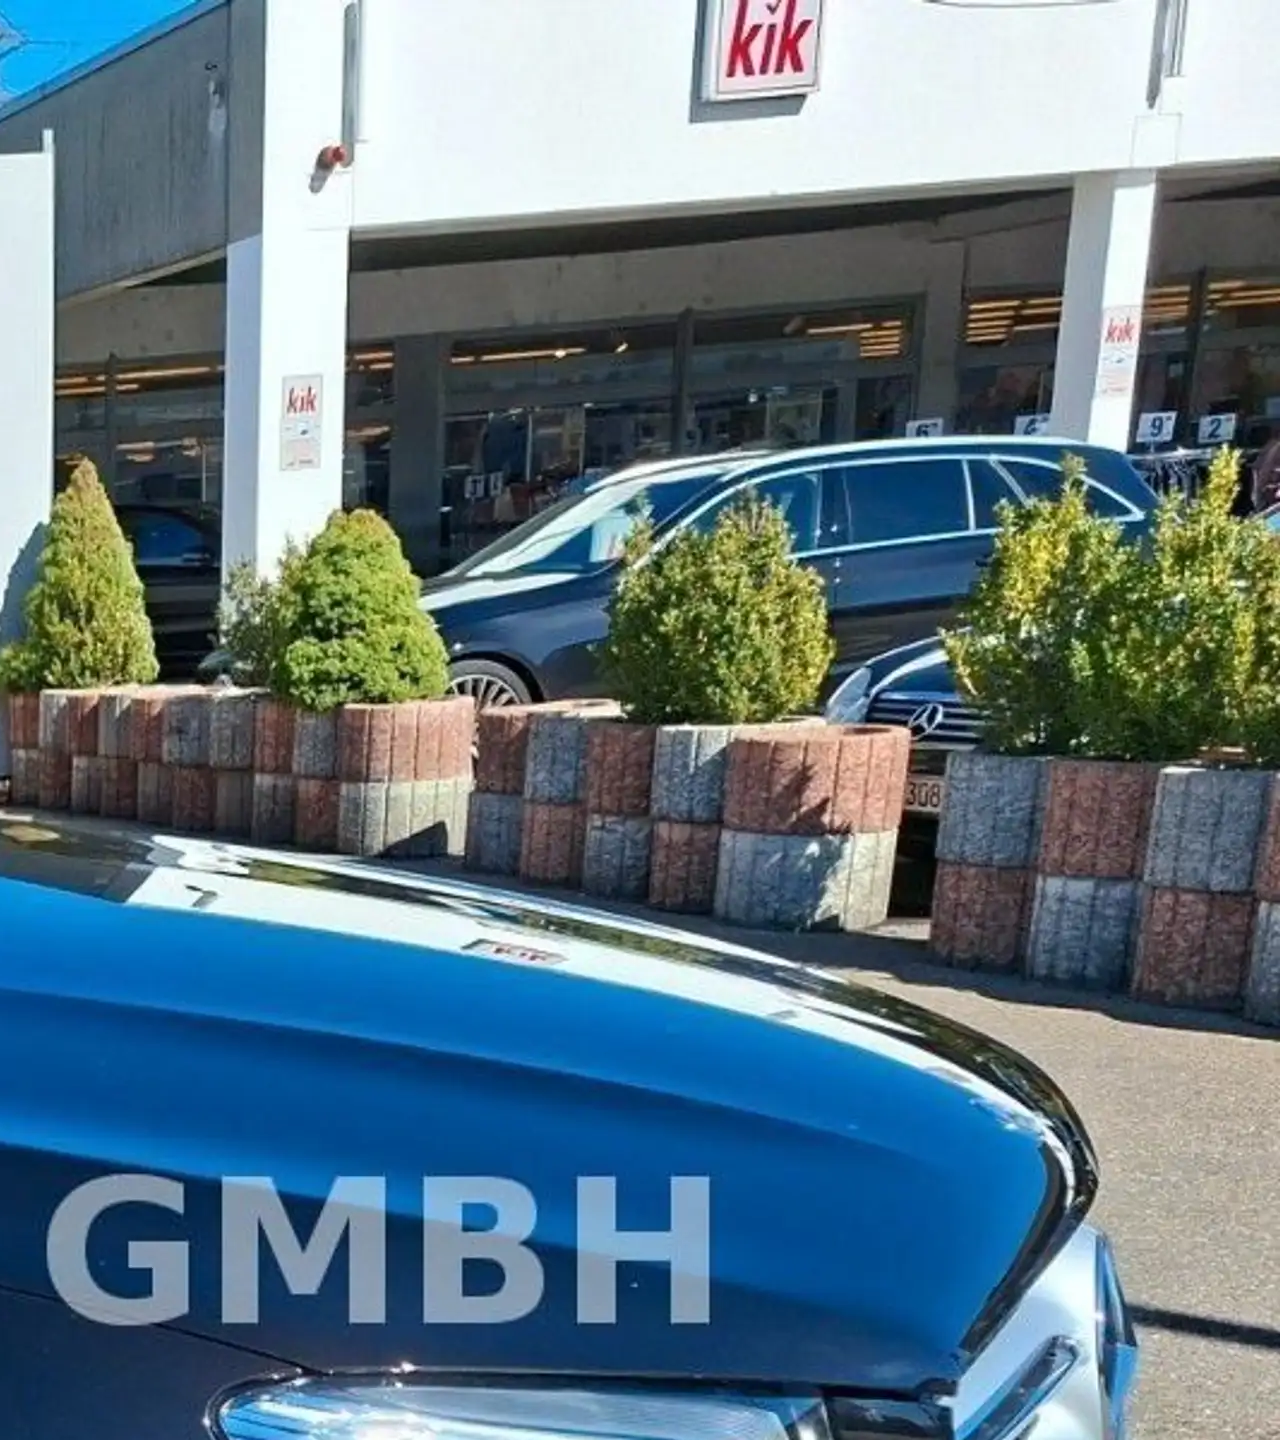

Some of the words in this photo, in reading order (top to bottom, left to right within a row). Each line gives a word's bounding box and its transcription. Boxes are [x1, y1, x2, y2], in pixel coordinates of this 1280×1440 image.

[725, 0, 814, 78] kik
[1104, 316, 1135, 343] kik
[286, 384, 317, 414] kik
